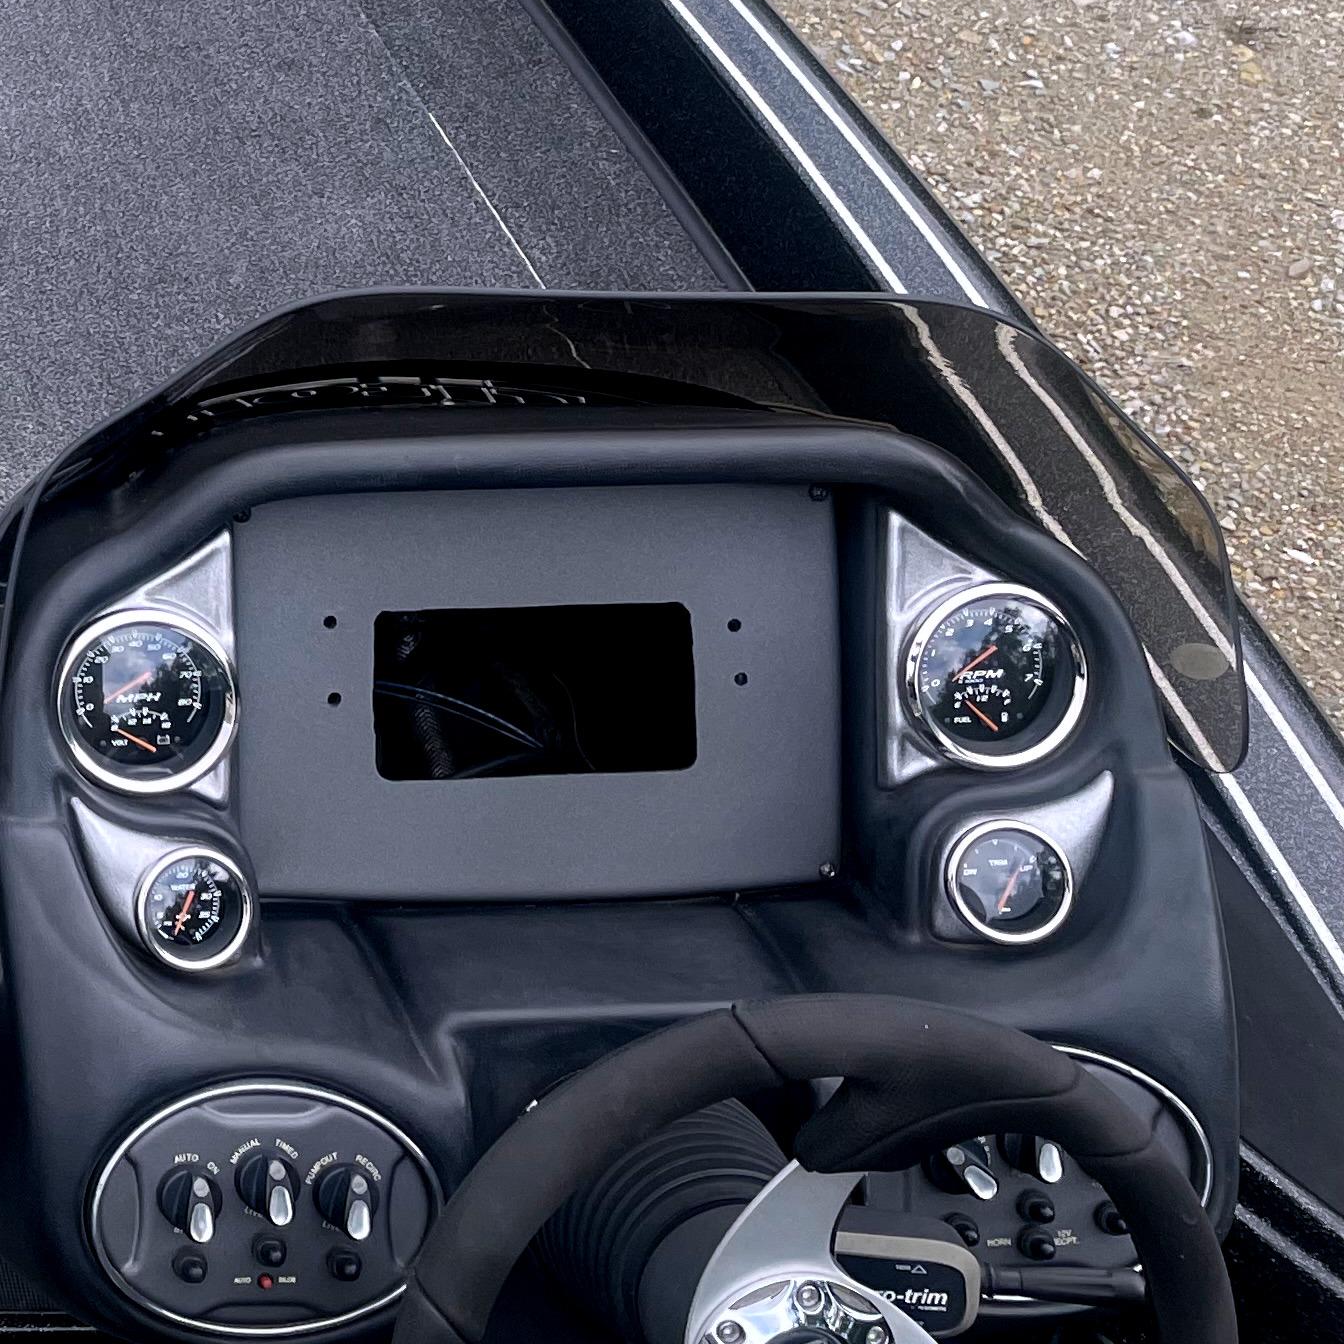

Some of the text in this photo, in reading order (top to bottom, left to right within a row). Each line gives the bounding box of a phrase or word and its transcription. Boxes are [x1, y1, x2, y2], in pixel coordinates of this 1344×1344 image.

[984, 618, 993, 626] 4
[958, 669, 1004, 683] RPM
[931, 678, 941, 687] 0
[116, 692, 162, 703] MPH
[86, 703, 95, 711] 0
[111, 738, 129, 747] VOLT
[1019, 864, 1033, 872] UP
[230, 1138, 261, 1164] MANUAL
[275, 1138, 299, 1160] TIMED
[174, 1153, 200, 1164] AUTO
[206, 1161, 220, 1175] ON
[305, 1151, 338, 1185] PUMPOUT
[355, 1154, 382, 1182] RECIRC
[986, 1237, 1012, 1247] HORN
[873, 1288, 948, 1305] o-trim
